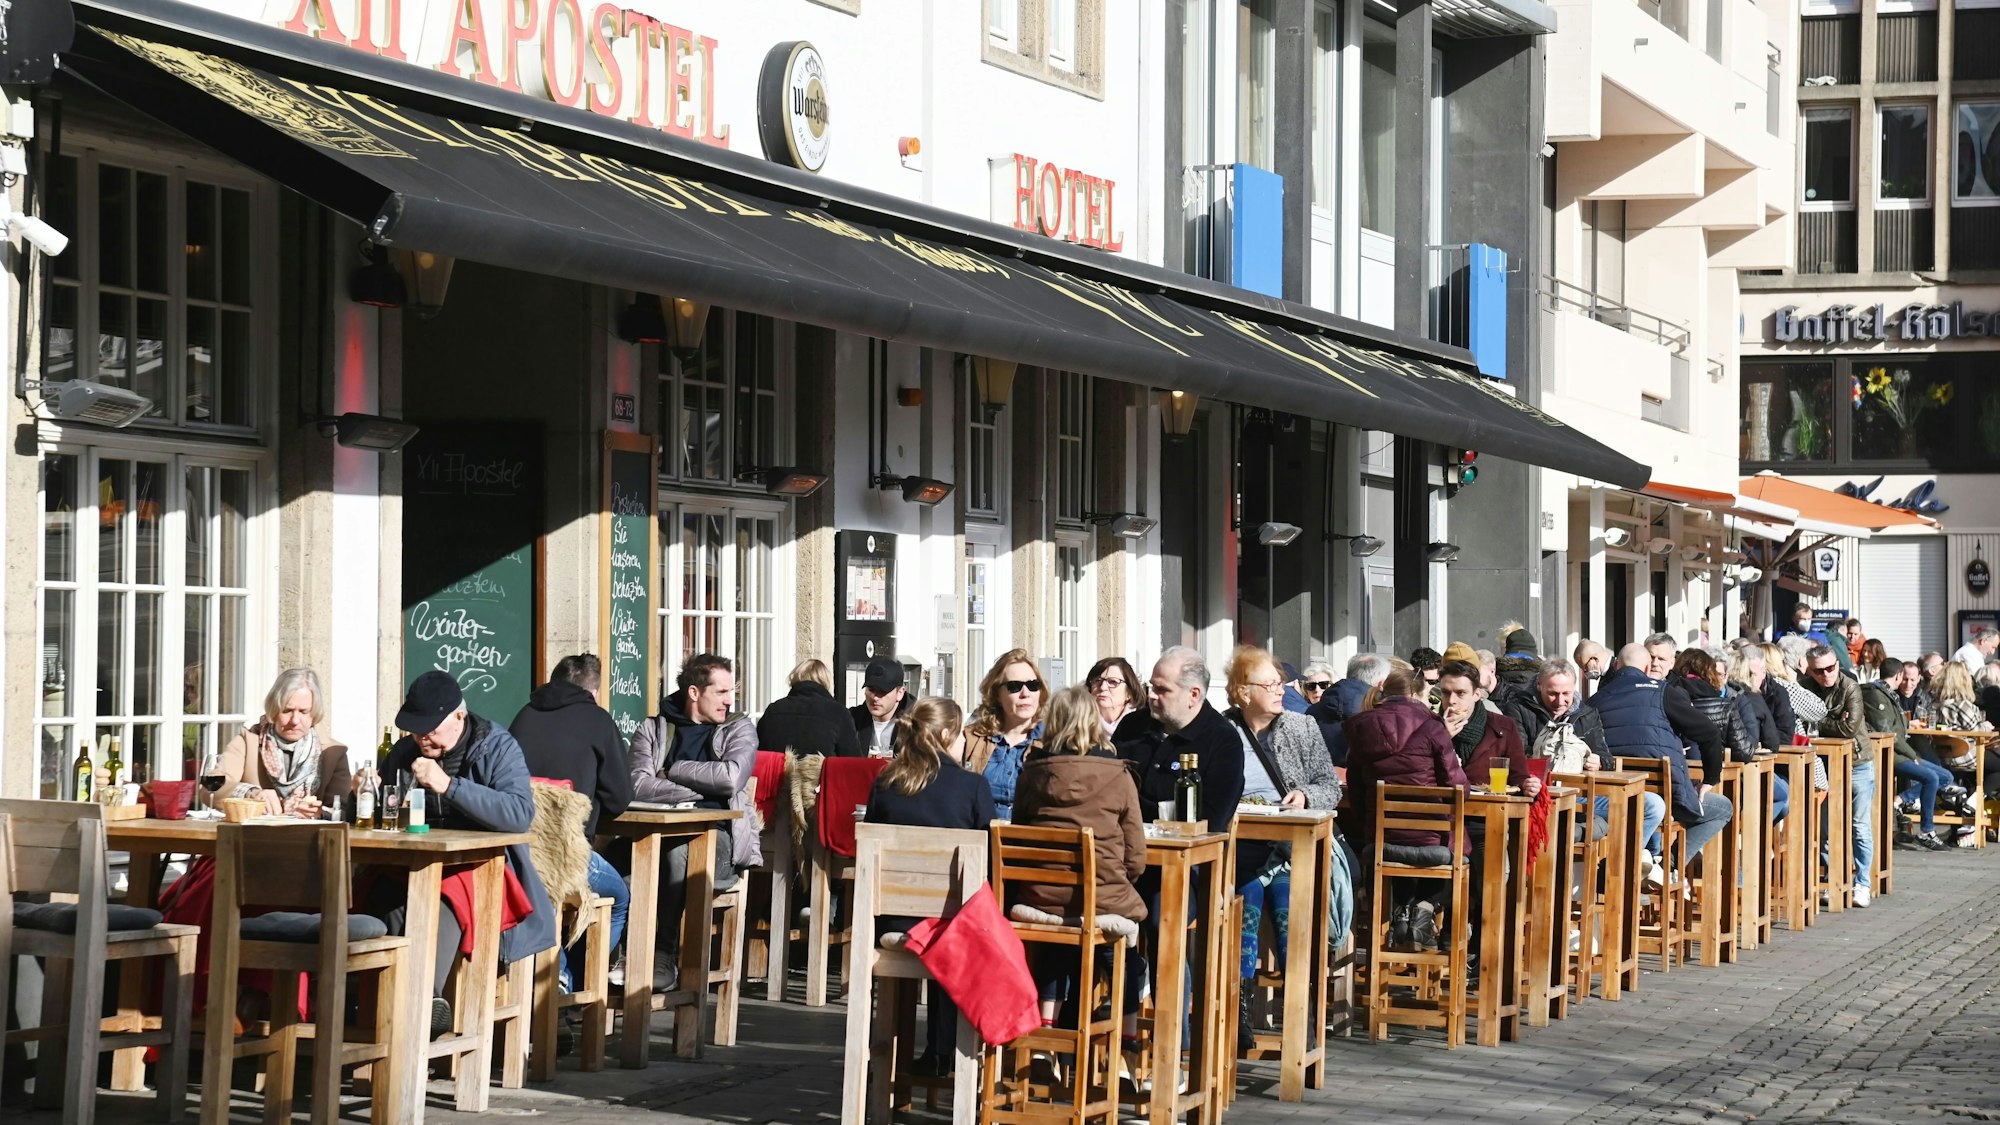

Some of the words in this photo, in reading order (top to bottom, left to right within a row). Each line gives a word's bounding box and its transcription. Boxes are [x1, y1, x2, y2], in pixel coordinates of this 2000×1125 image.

[438, 0, 731, 151] APOSTEL
[793, 85, 829, 125] Warstein
[1010, 152, 1125, 253] HOTEL
[614, 517, 628, 545] Sie
[410, 600, 496, 642] Winter-
[433, 640, 512, 674] garten
